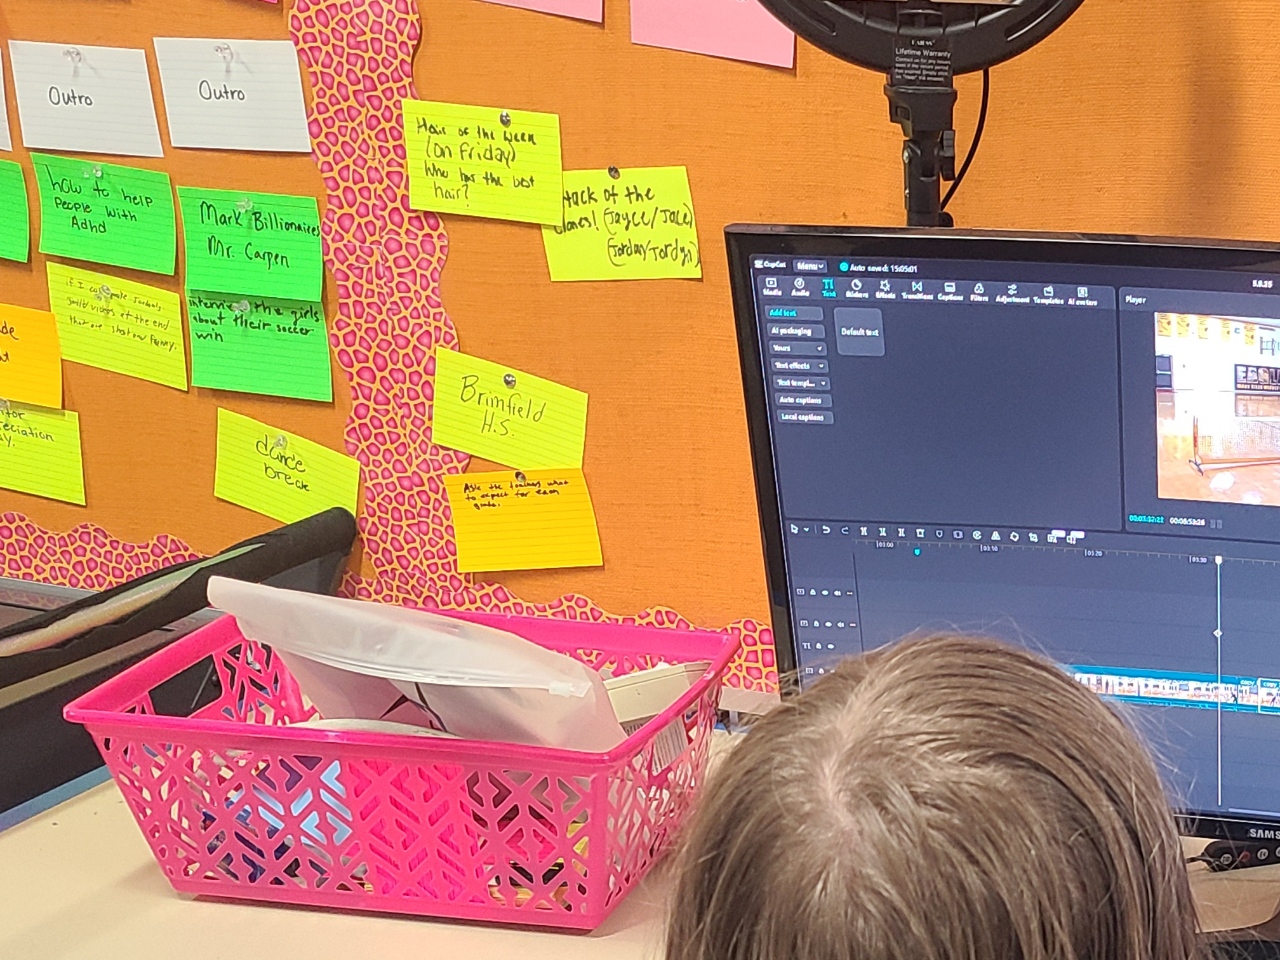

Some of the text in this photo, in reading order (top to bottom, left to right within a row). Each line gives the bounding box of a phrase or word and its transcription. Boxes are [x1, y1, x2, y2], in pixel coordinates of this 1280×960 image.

[895, 48, 951, 59] Lifetime Warranty
[49, 86, 93, 106] Outro
[199, 80, 246, 101] Outro
[416, 117, 447, 134] Hair
[458, 126, 469, 137] of
[477, 125, 495, 140] the
[45, 164, 153, 207] how to help
[459, 167, 476, 183] has
[483, 171, 504, 187] the
[513, 175, 535, 188] best
[433, 181, 469, 207] hair?
[603, 185, 619, 204] of
[624, 184, 655, 204] the
[71, 216, 107, 233] Adhd
[207, 235, 290, 270] Mr. Carpen
[764, 261, 786, 270] CapCut
[797, 262, 818, 271] Menu
[850, 264, 866, 272] Auto
[867, 264, 889, 273] saved:
[791, 289, 810, 297] Audio
[822, 290, 836, 298] Text
[846, 291, 868, 299] Stickers
[876, 292, 896, 300] Effects
[902, 292, 933, 300] Transitions
[937, 293, 964, 302] Captions
[970, 294, 989, 302] Filters
[995, 295, 1030, 305] Adjustment
[1033, 296, 1064, 305] Templates
[1068, 298, 1076, 306] AI
[1076, 299, 1098, 307] avatars
[1125, 295, 1146, 305] Player
[254, 300, 283, 316] the
[291, 304, 320, 326] girls
[769, 309, 782, 317] Add
[193, 311, 314, 336] about their soccer
[771, 327, 812, 337] AI packaging
[195, 327, 224, 343] win
[841, 328, 879, 337] Default text
[773, 344, 791, 352] Yours
[789, 362, 810, 370] effects
[460, 374, 547, 423] Brimfield
[779, 396, 822, 406] Auto captions
[481, 409, 515, 437] H.S.
[781, 413, 824, 422] Local captions
[256, 434, 306, 473] dance
[480, 491, 509, 500] expect
[514, 489, 530, 498] for
[488, 483, 503, 491] the
